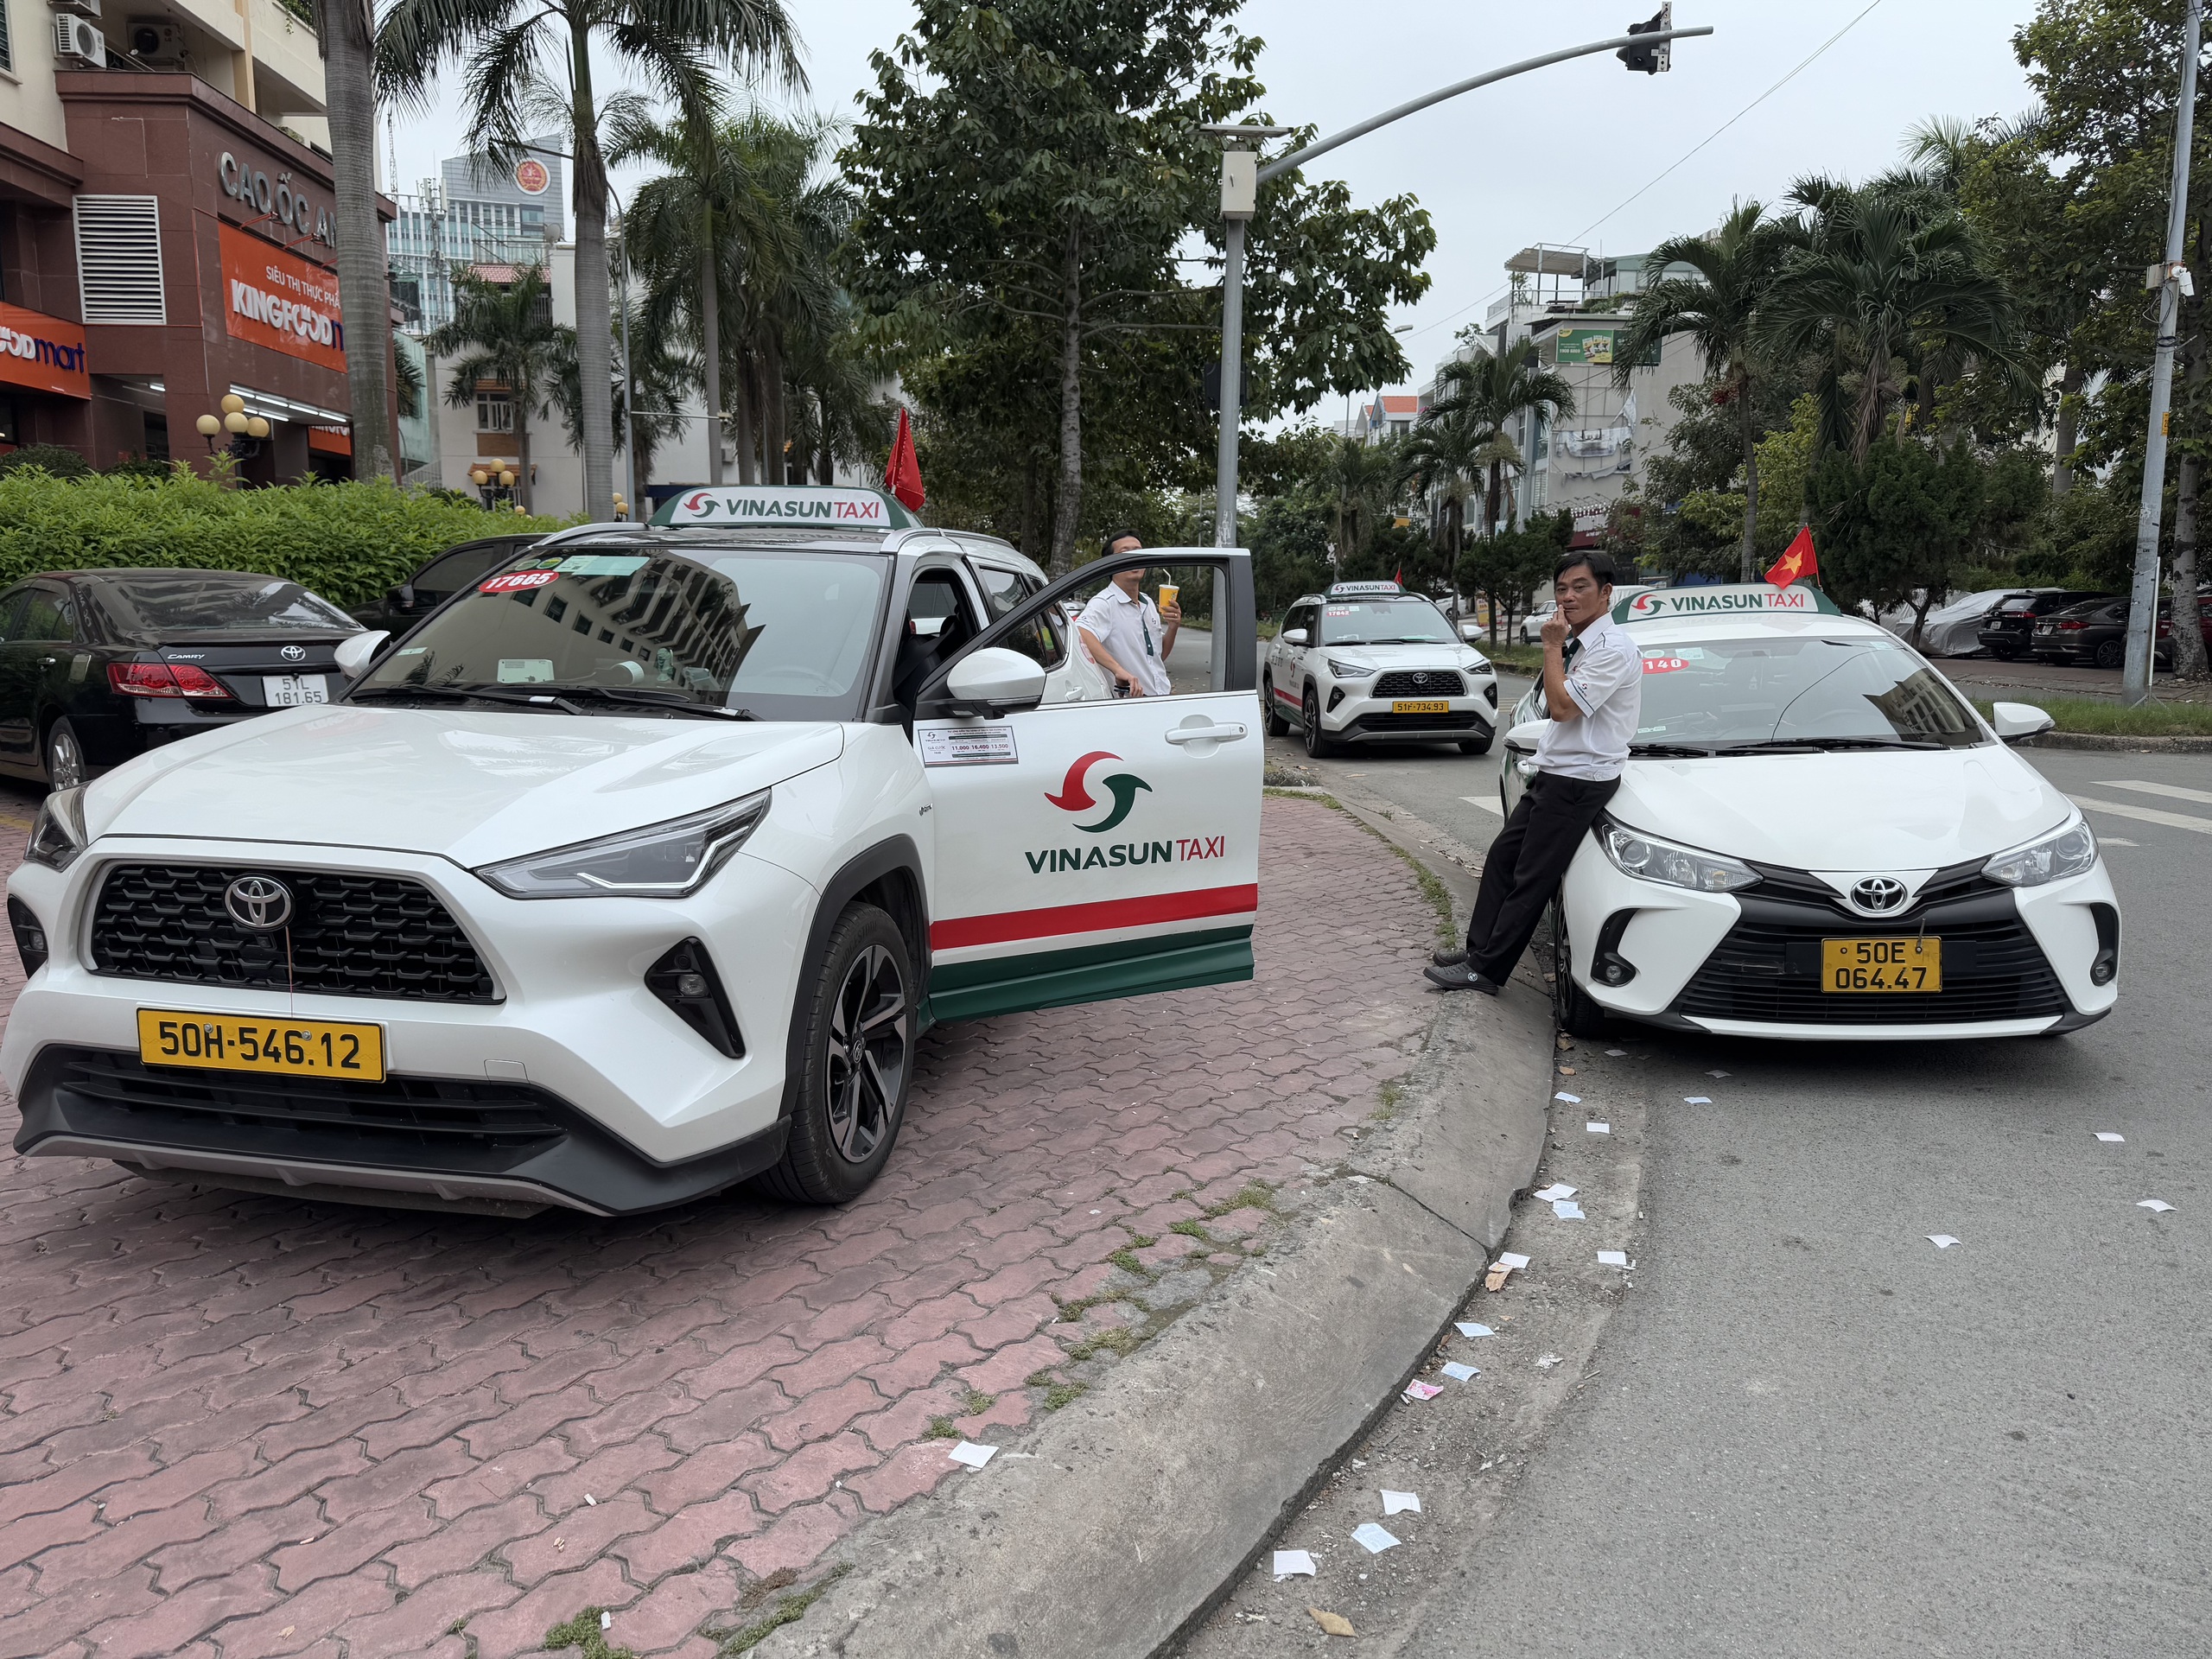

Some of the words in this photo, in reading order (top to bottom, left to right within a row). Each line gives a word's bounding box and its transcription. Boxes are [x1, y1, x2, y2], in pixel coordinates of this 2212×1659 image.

[218, 151, 272, 214] CAO
[276, 172, 310, 235] ỐC
[266, 265, 285, 286] SIÊU
[286, 274, 302, 296] THỊ
[302, 280, 323, 303] THỰC
[726, 499, 880, 518] VINASUNTAXI
[486, 572, 555, 589] 17665
[1670, 593, 1804, 612] VINASUNTAXI
[1642, 658, 1682, 670] 140
[282, 677, 309, 690] 51L
[275, 690, 322, 705] 181.65
[1397, 702, 1444, 711] 51F-734.93
[1856, 942, 1906, 963] 50E
[1835, 967, 1927, 989] 064.47
[159, 1020, 361, 1070] 50H-546.12
